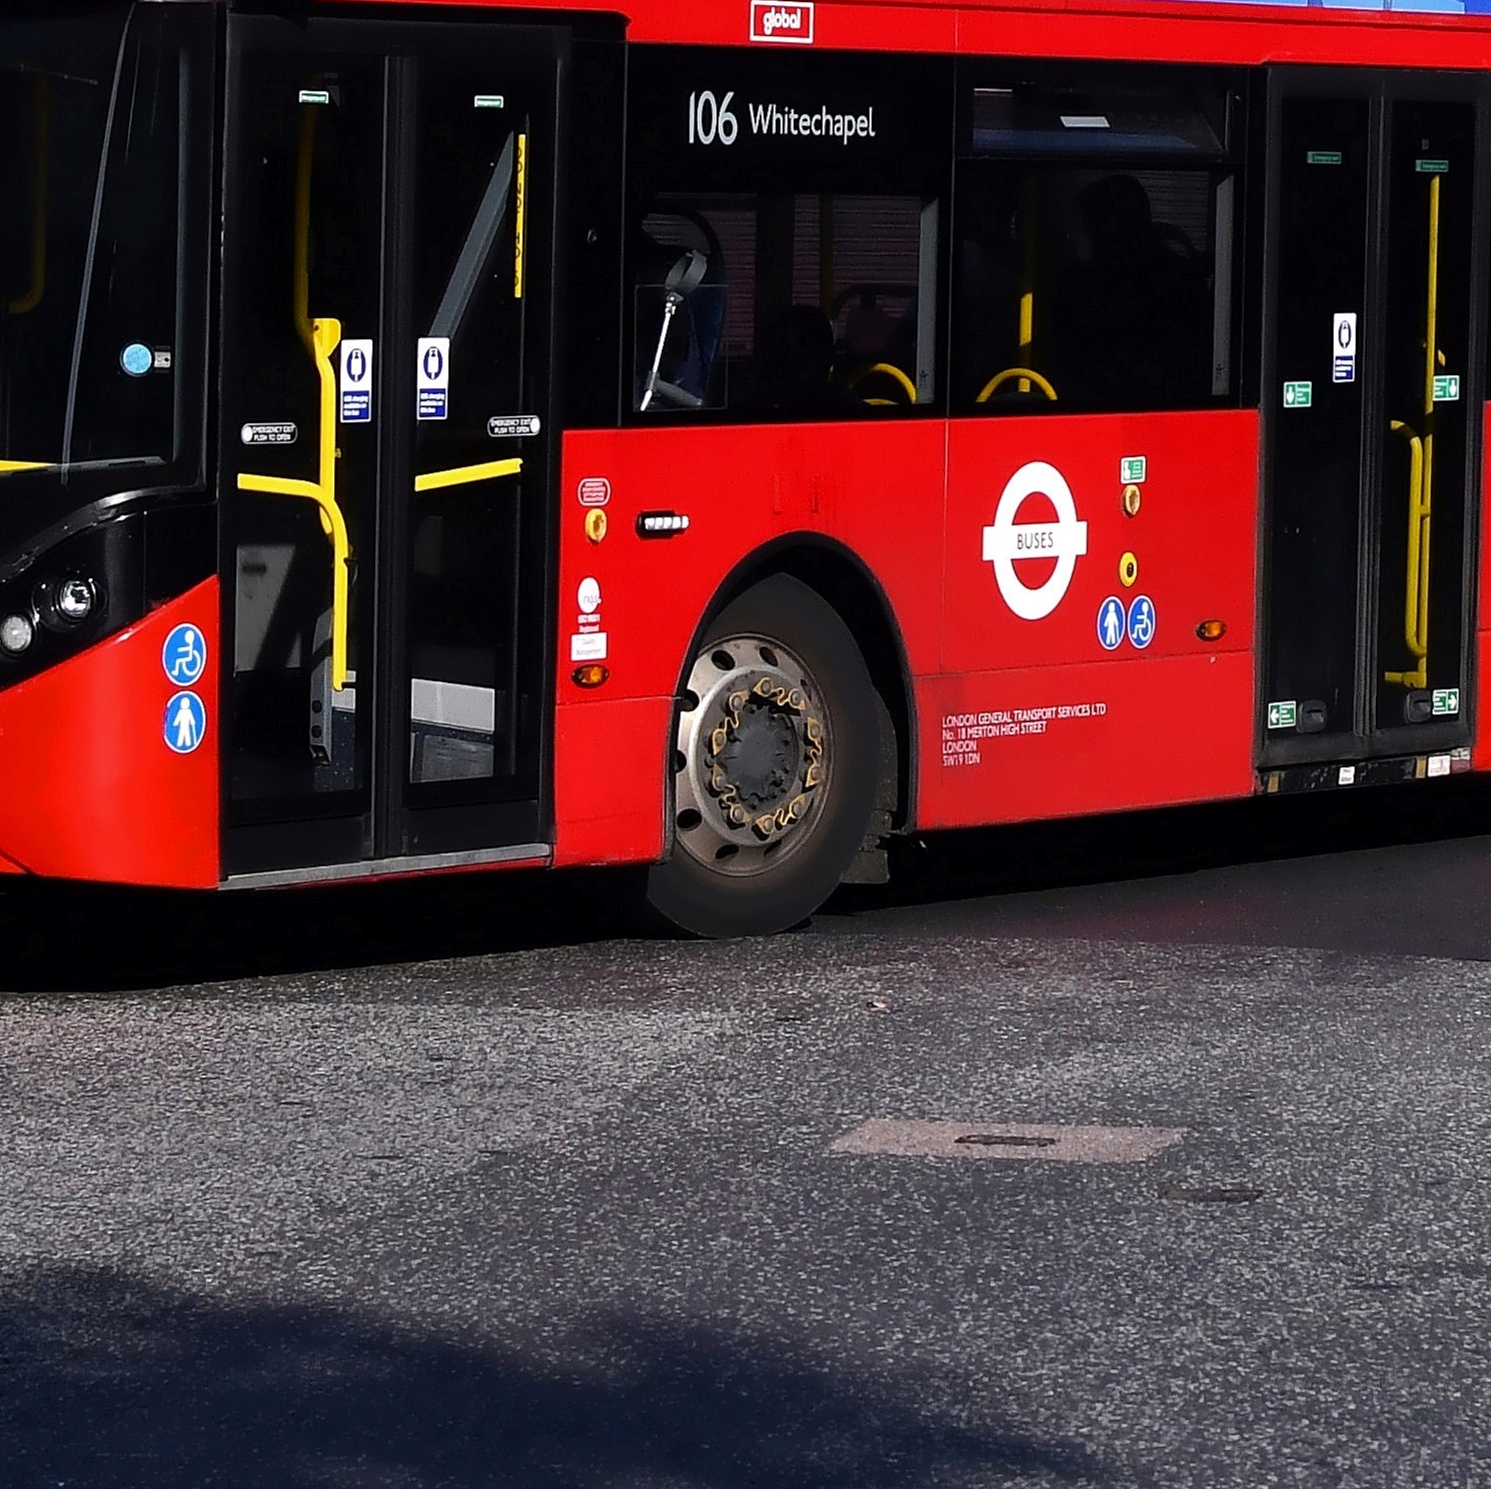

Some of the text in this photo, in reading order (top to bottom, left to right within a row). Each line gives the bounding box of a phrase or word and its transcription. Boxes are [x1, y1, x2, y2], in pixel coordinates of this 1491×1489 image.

[763, 6, 801, 36] global
[688, 90, 876, 146] 106 Whitechapel
[1016, 531, 1054, 551] BUSES
[942, 703, 1107, 729] LONDON GENERAL TRANSPORT SERVICES LTD
[942, 728, 956, 742] No.
[967, 724, 1001, 739] MERTON
[1000, 722, 1021, 736] HIGH
[1020, 720, 1048, 735] STREET
[942, 740, 978, 754] LONDON
[942, 752, 981, 767] SW19 1DN
